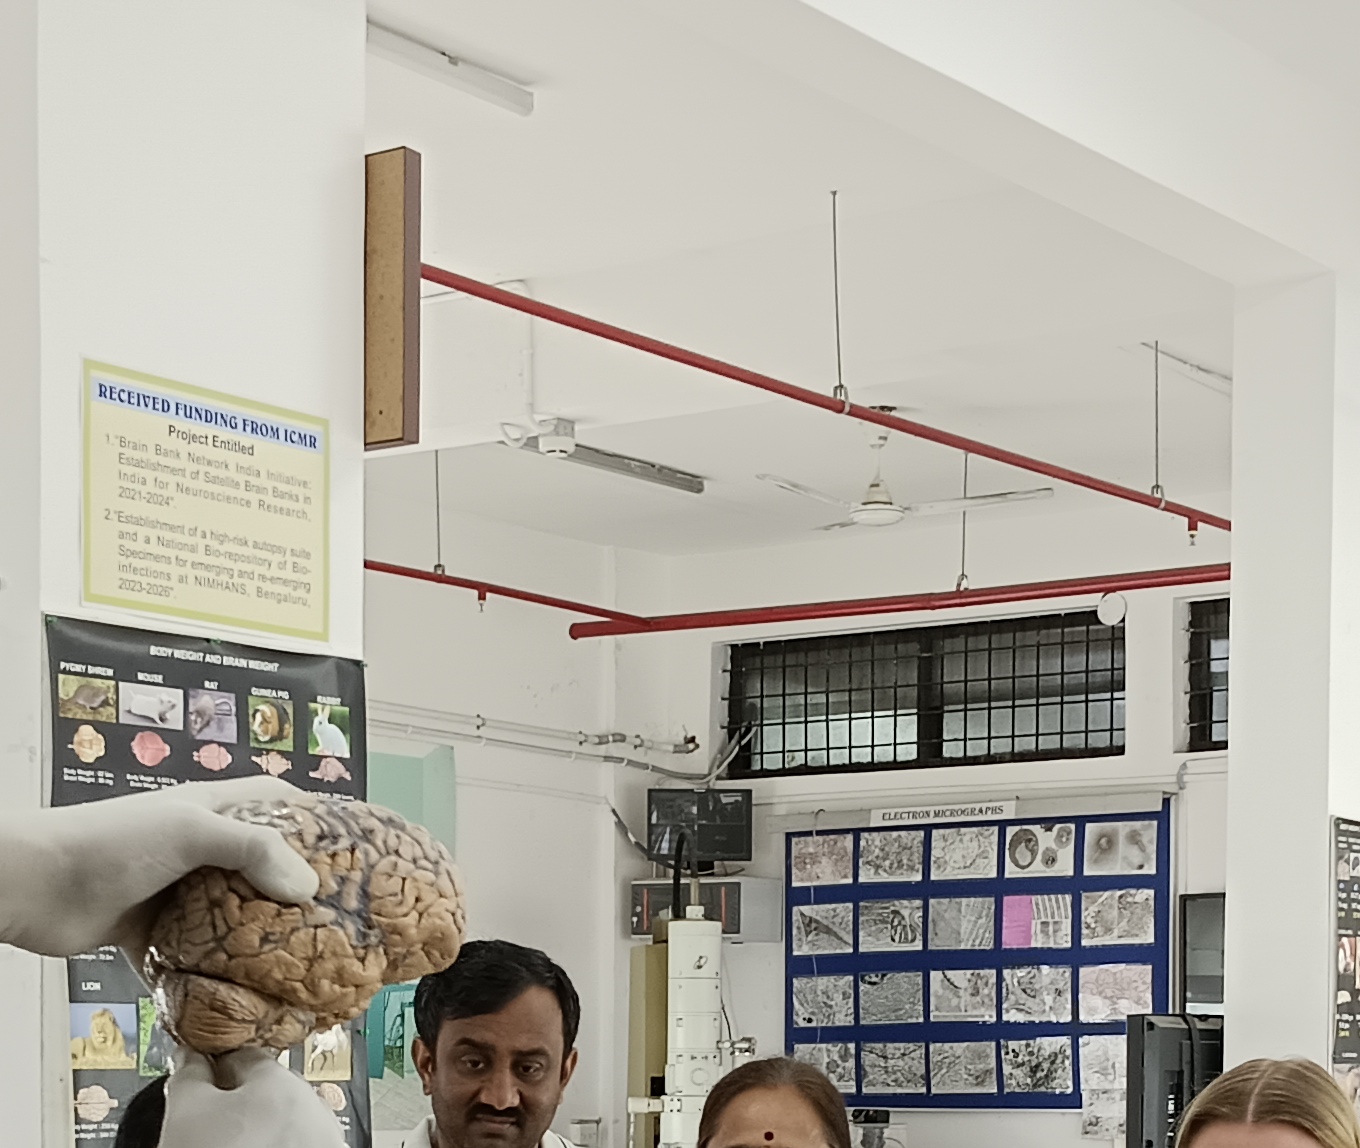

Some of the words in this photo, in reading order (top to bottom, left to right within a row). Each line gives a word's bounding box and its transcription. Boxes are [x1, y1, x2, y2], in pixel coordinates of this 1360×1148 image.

[98, 383, 171, 413] RECEIVED
[175, 402, 238, 430] FUNDING
[242, 418, 280, 440] FROM
[284, 428, 317, 449] ICMR
[168, 424, 209, 446] Project
[212, 435, 254, 456] Entitled
[154, 443, 181, 460] Bank
[188, 451, 230, 471] Network
[236, 462, 261, 479] India
[118, 452, 187, 478] Establishment
[190, 470, 200, 480] of
[204, 471, 240, 490] Satellite
[245, 480, 269, 496] Brain
[272, 486, 300, 503] Banks
[303, 493, 312, 505] in
[118, 469, 147, 486] India
[154, 476, 170, 490] for
[176, 482, 252, 508] Neuroscience
[118, 530, 138, 542] and
[157, 536, 198, 554] National
[205, 544, 272, 571] Bio-repository
[277, 560, 287, 570] of
[188, 526, 198, 537] of
[211, 529, 249, 548] high-risk
[252, 540, 287, 558] autopsy
[290, 548, 311, 560] suite
[118, 544, 172, 565] Specimens
[175, 555, 188, 567] for
[191, 560, 234, 580] emerging
[237, 569, 255, 581] and
[258, 572, 311, 594] re-emerging
[118, 561, 172, 581] infections
[178, 574, 188, 585] at
[150, 645, 172, 658] BODY
[173, 648, 204, 662] WEIGHT
[204, 652, 222, 665] AND
[223, 655, 247, 669] BRAIN
[247, 660, 279, 672] WEIGHT
[204, 680, 219, 689] RAT
[882, 810, 931, 821] ELECTRON
[933, 805, 1004, 819] MICROGRAPHS
[81, 981, 101, 991] LION
